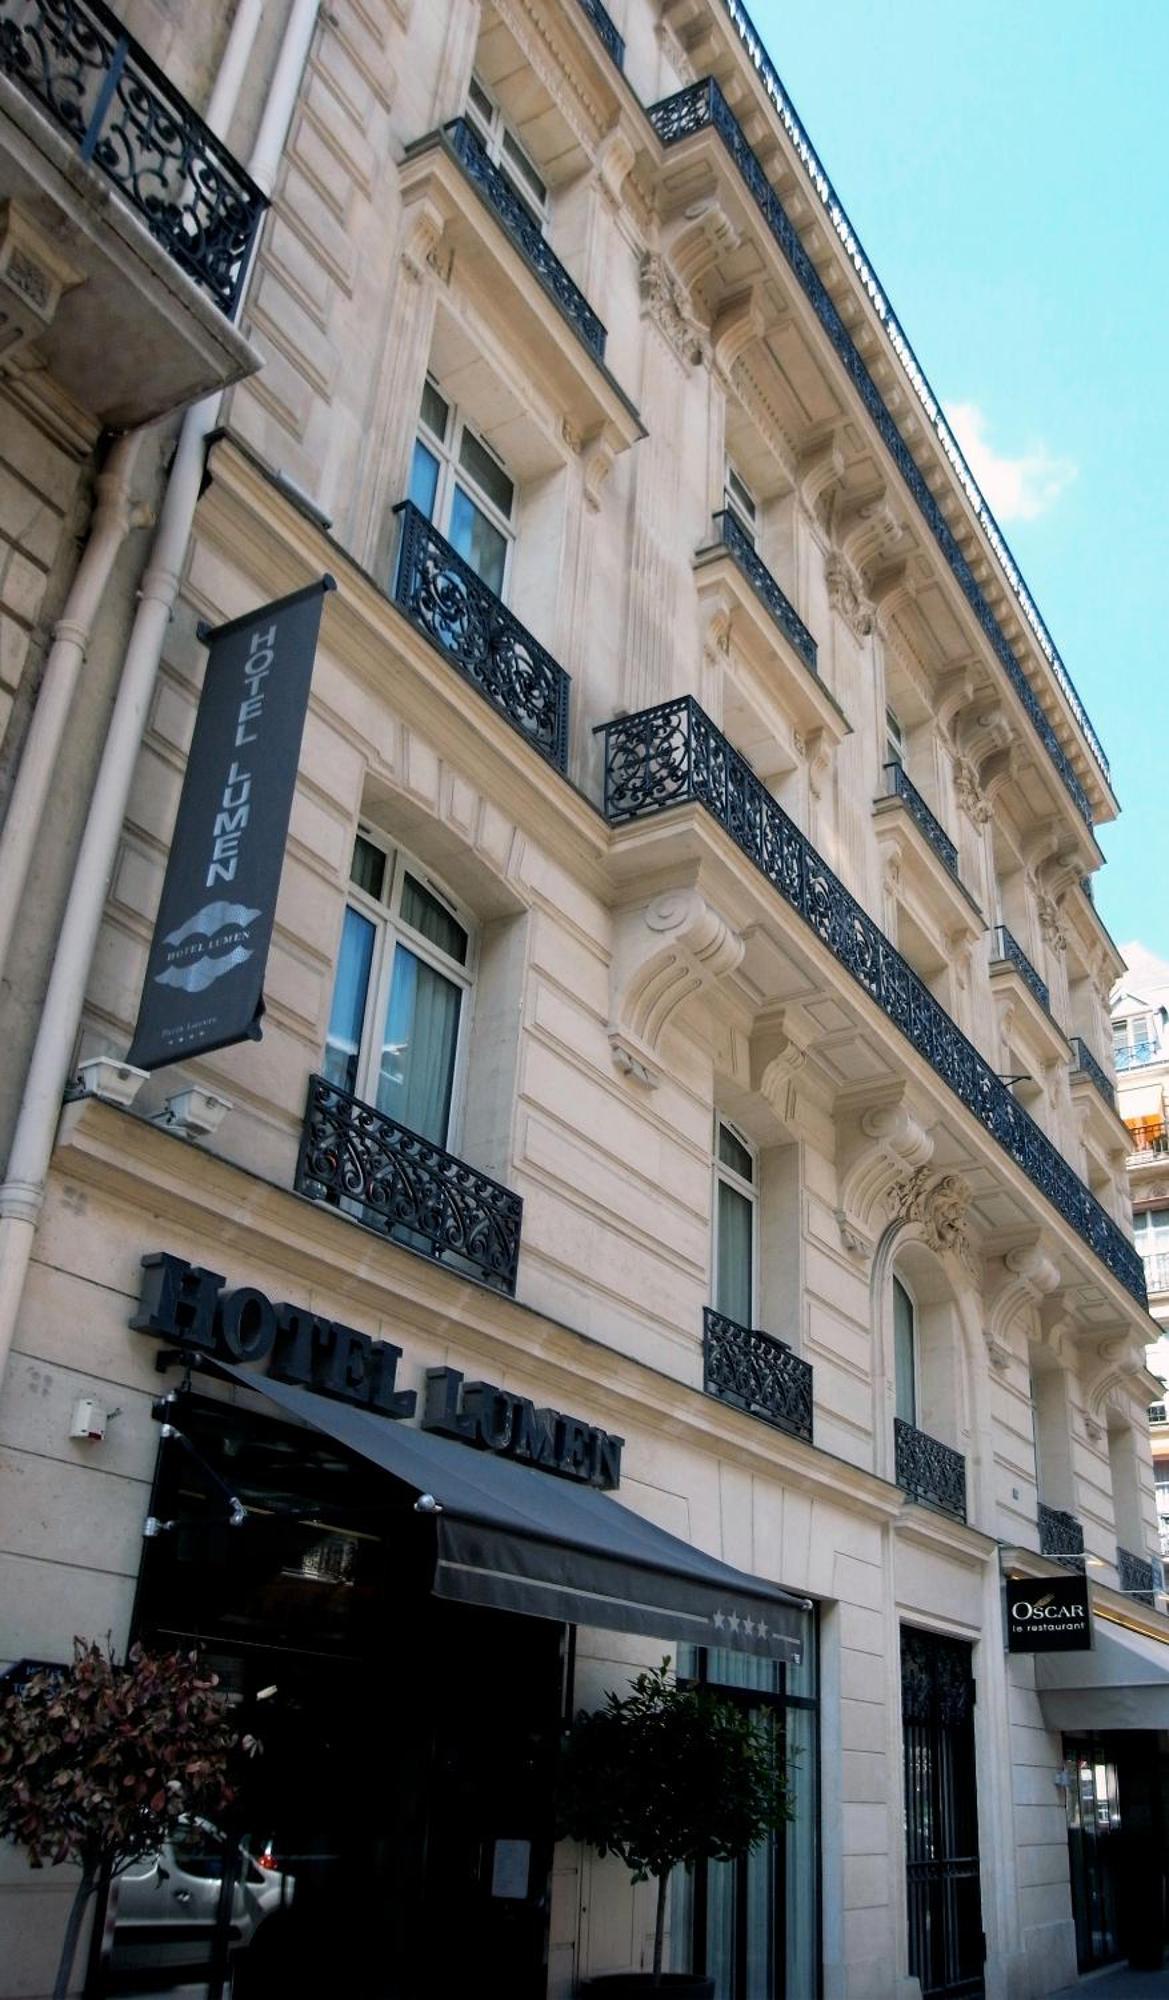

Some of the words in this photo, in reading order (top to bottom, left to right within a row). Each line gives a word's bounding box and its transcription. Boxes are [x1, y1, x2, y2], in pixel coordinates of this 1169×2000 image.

[234, 624, 277, 748] HOTEL
[206, 761, 252, 888] LUMEN
[167, 943, 204, 961] HOTEL
[208, 931, 251, 950] LUMEN
[129, 1251, 418, 1420] HOTEL
[421, 1366, 626, 1490] LUMEN
[1012, 1602, 1084, 1620] OSCAR
[1012, 1624, 1024, 1633] le
[1027, 1622, 1085, 1632] restaurant
